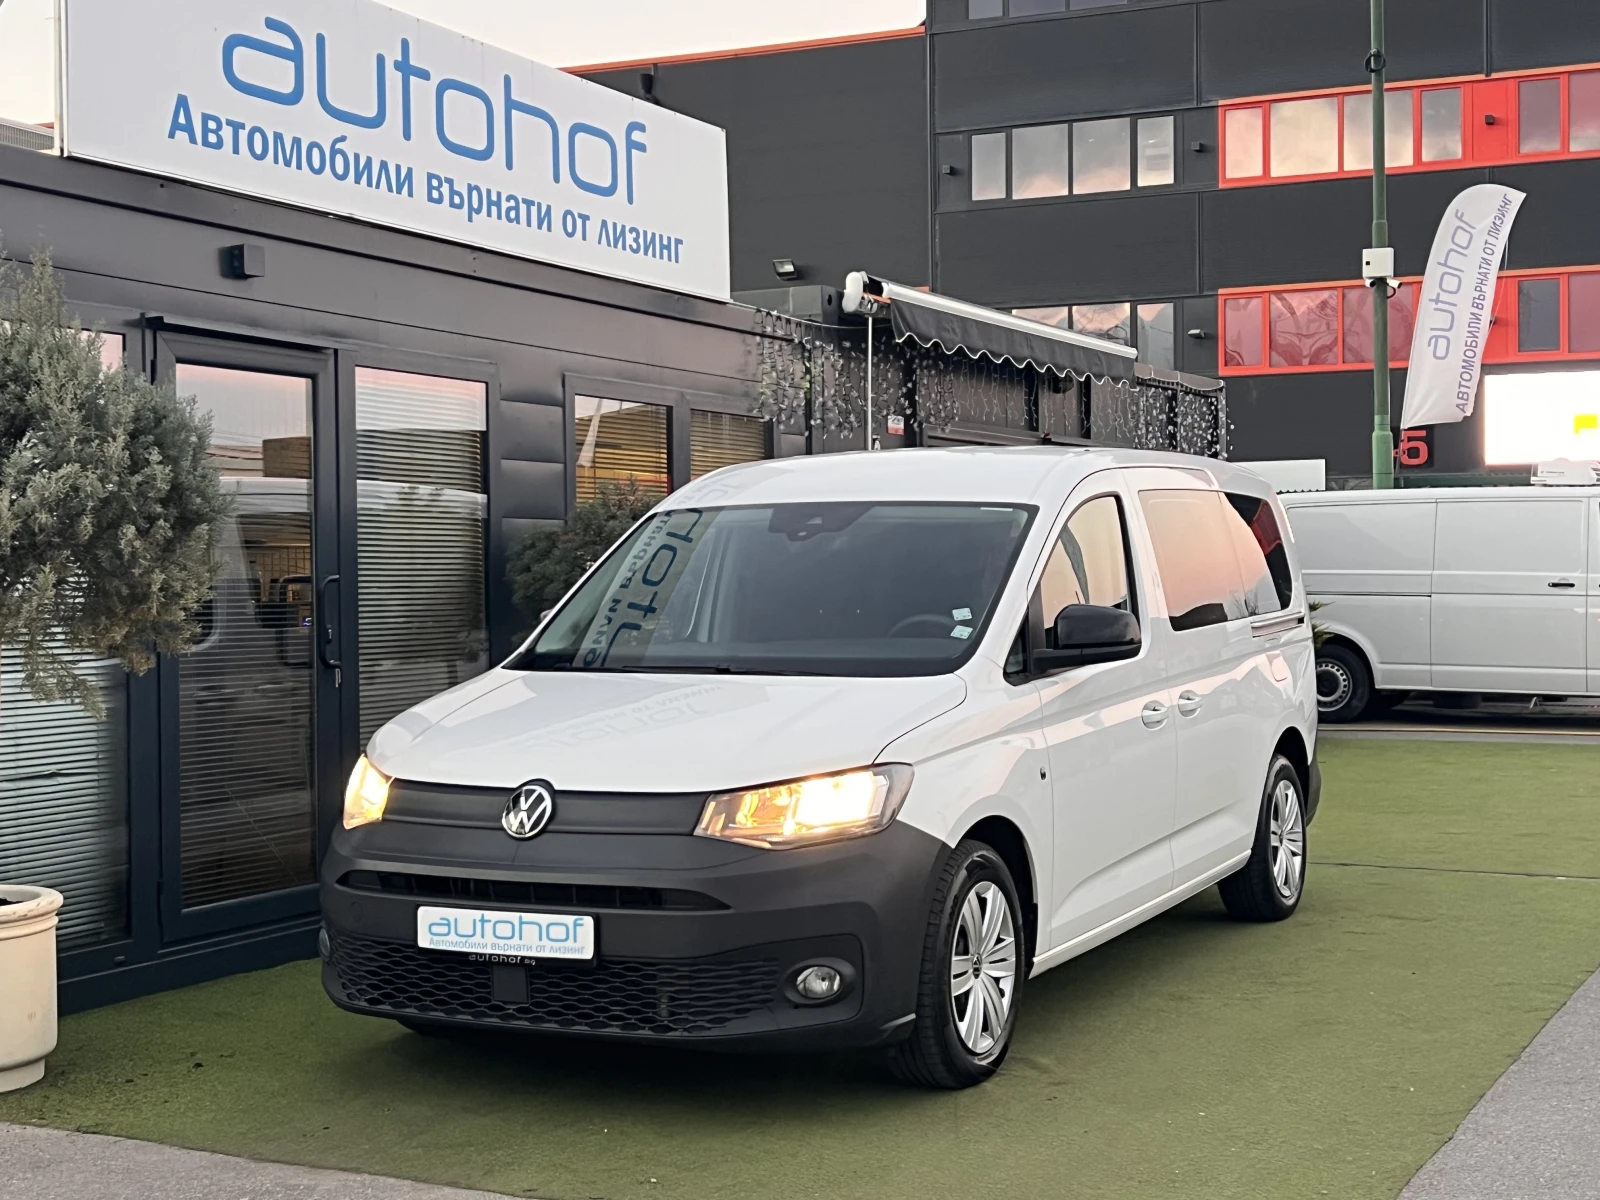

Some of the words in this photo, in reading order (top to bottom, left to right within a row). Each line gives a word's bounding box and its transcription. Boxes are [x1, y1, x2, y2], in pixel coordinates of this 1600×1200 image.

[222, 16, 648, 205] autohof
[168, 92, 415, 199] Автомобили
[426, 170, 553, 233] върнати
[562, 210, 591, 243] от
[598, 216, 684, 264] лизинг
[1487, 193, 1512, 240] ЛИЗИНГ
[1482, 239, 1497, 256] ОТ
[1428, 208, 1477, 360] autohof
[1471, 256, 1493, 310] ВЪРНАТИ
[1456, 312, 1482, 413] АВТОМОБИЛИ
[1400, 430, 1428, 465] 5
[428, 913, 584, 943] autohof
[429, 937, 488, 951] Автомобили
[490, 942, 533, 953] върнати
[535, 944, 546, 953] от
[549, 945, 585, 955] лизинг
